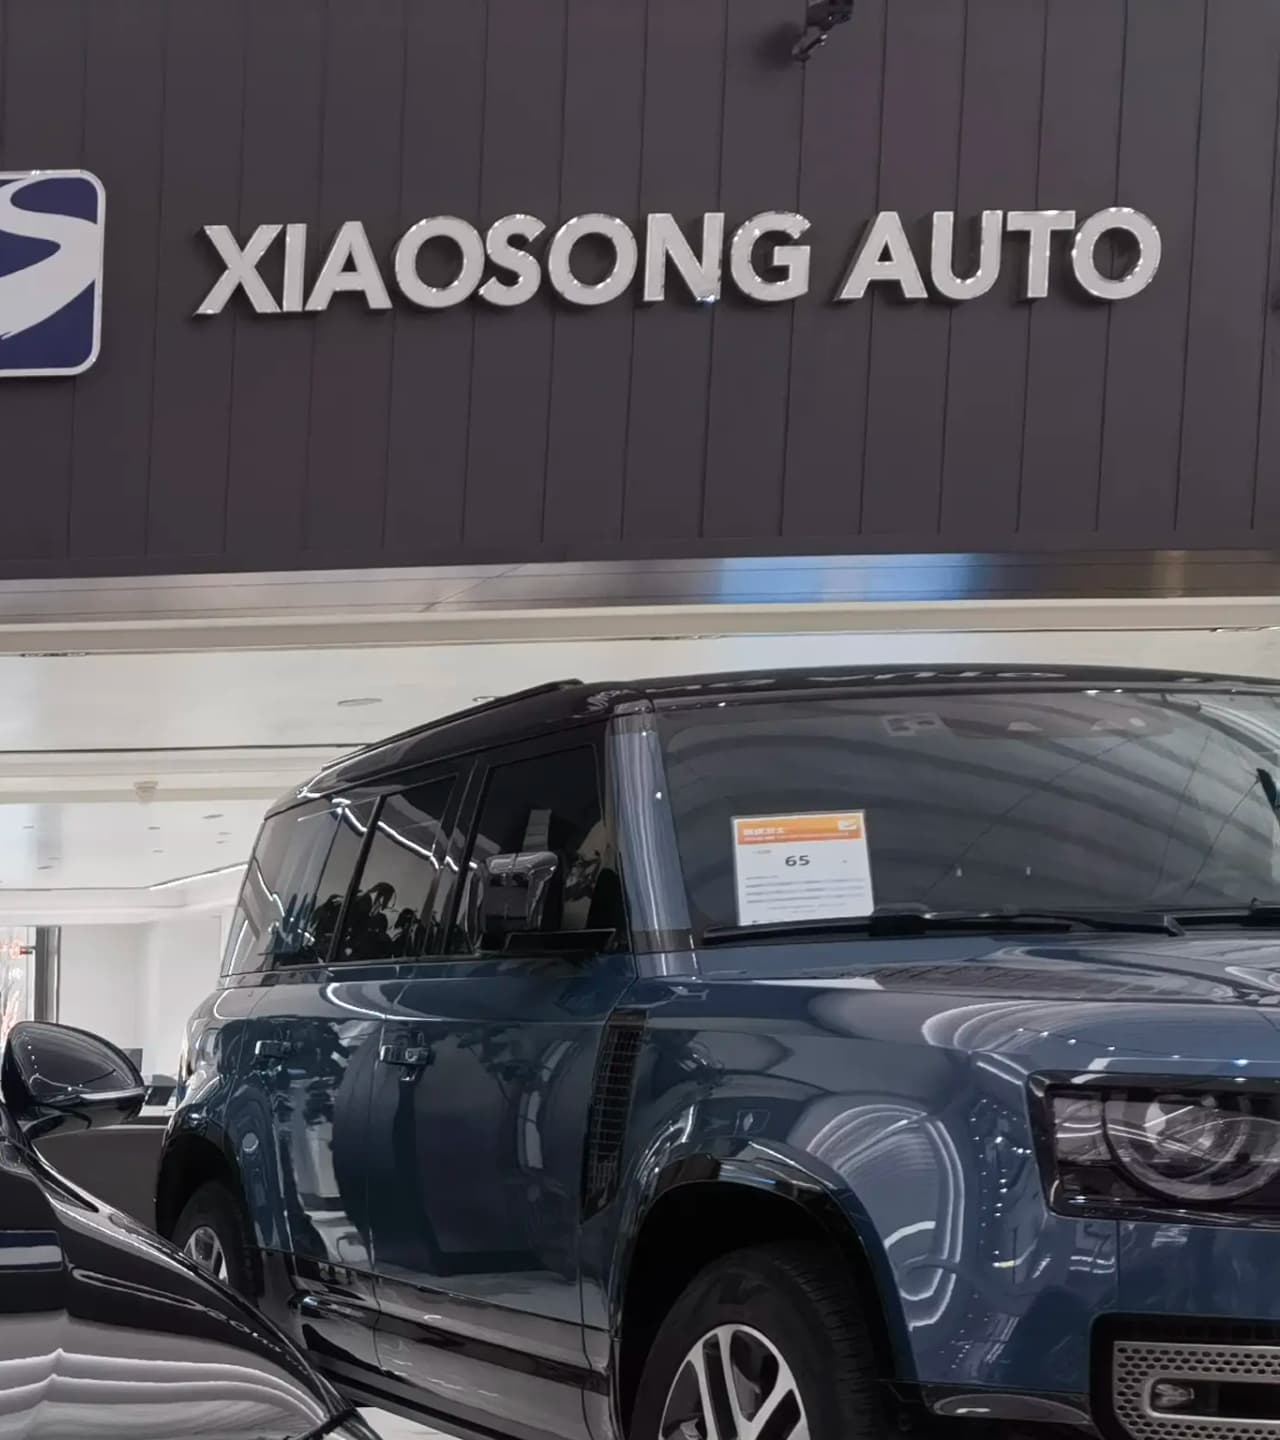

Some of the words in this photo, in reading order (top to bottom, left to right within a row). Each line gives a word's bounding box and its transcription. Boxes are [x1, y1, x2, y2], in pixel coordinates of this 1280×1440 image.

[194, 212, 813, 316] XIAOSONG
[834, 206, 1162, 301] AUTO
[785, 854, 811, 867] 65
